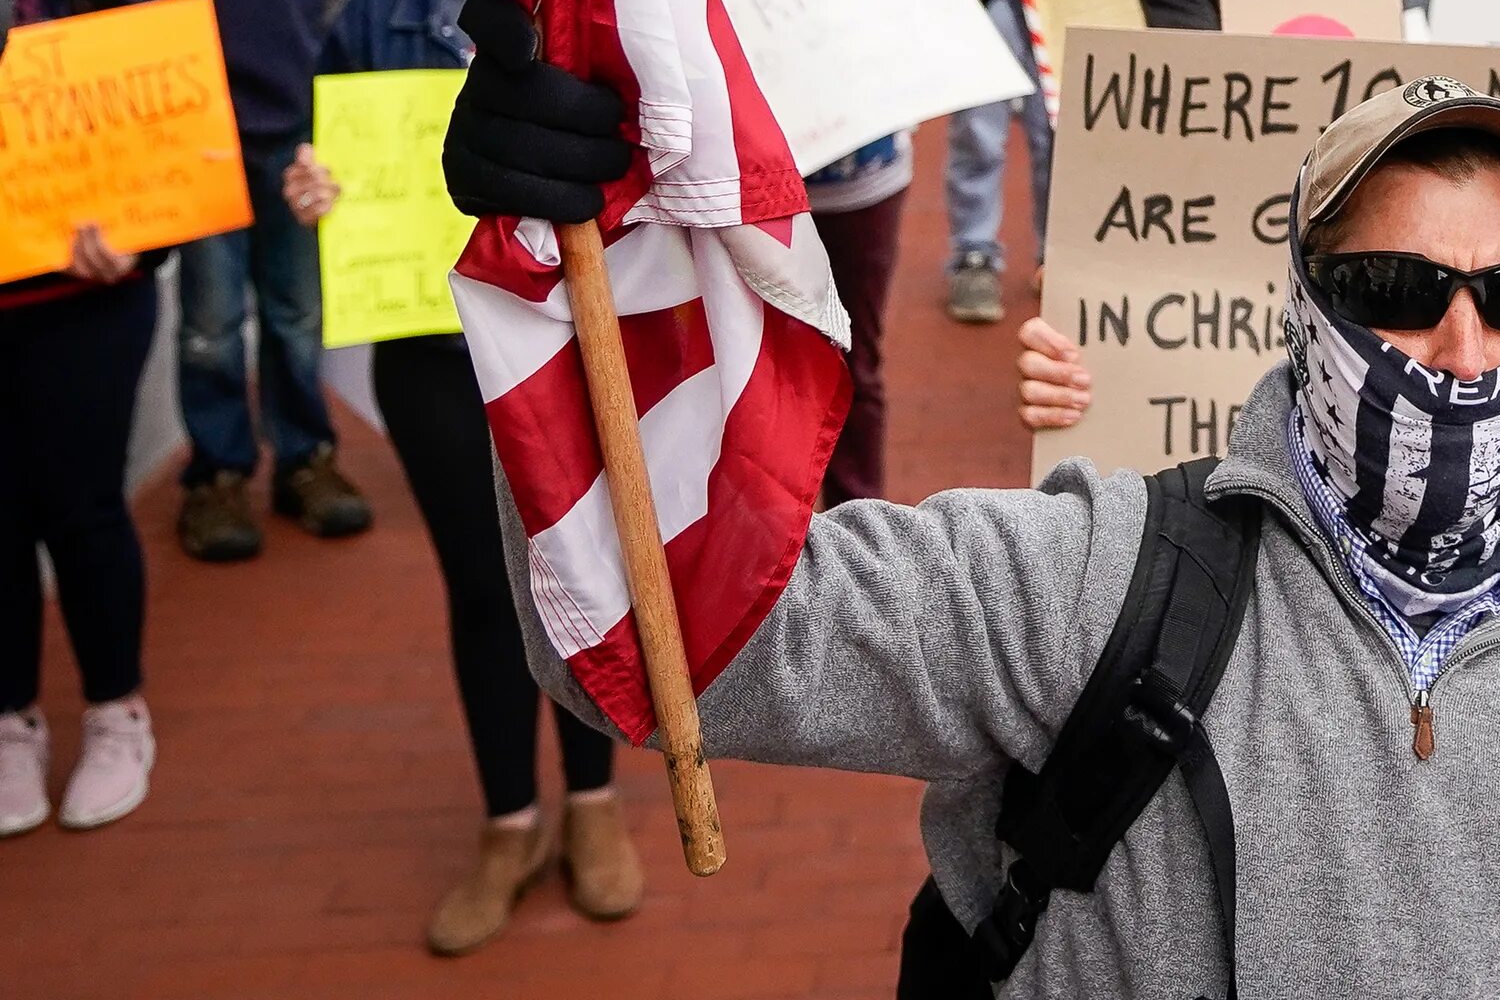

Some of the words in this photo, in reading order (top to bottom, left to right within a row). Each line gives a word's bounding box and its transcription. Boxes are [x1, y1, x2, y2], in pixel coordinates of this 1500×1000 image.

[1081, 53, 1299, 142] WHERE
[1095, 185, 1216, 243] ARE
[1078, 297, 1129, 348] IN
